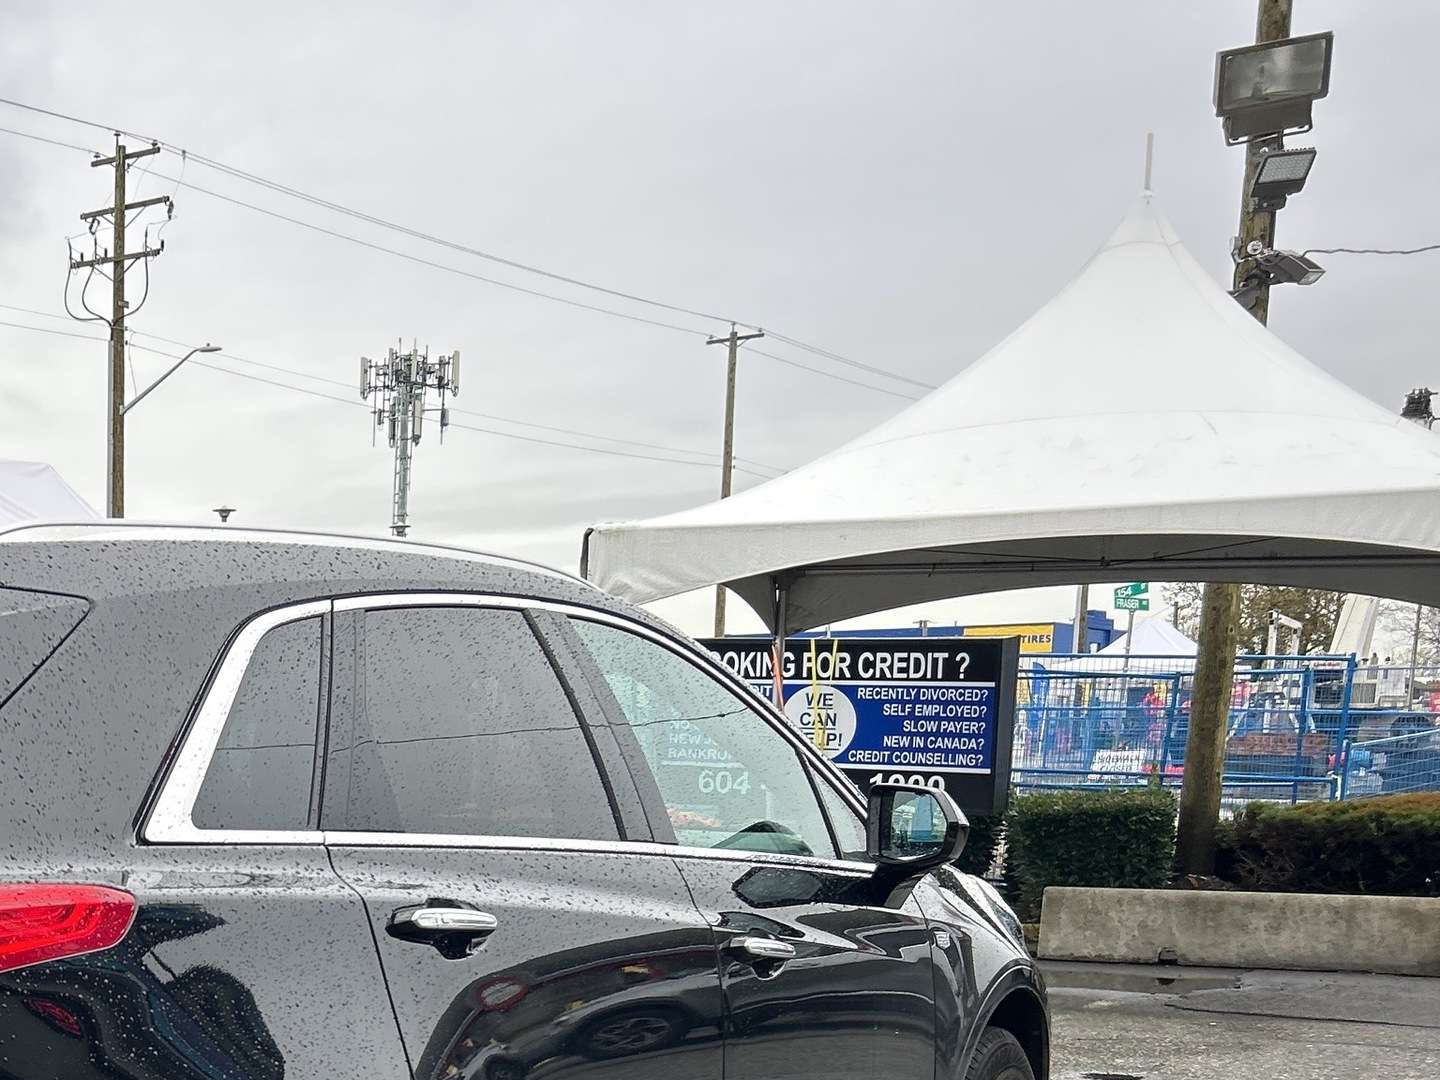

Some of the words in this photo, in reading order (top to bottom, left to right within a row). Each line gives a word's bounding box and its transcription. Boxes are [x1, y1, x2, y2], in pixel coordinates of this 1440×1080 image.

[1117, 598, 1139, 609] FRASER
[1020, 634, 1052, 643] TIRES
[802, 652, 851, 679] FOR
[857, 652, 949, 679] CREDIT
[955, 652, 970, 679] ?
[805, 692, 834, 707] WE
[857, 687, 917, 700] RECENTLY
[920, 688, 989, 702] DIVORCED?
[882, 703, 912, 716] SELF
[915, 704, 987, 718] EMPLOYED?
[800, 712, 837, 727] CAN
[903, 720, 938, 733] SLOW
[940, 721, 986, 734] PAYER?
[883, 736, 910, 748] NEW
[912, 737, 924, 749] IN
[927, 737, 985, 751] CANADA?
[848, 750, 890, 763] CREDIT
[892, 751, 984, 767] COUNSELLING?
[698, 769, 751, 795] 604
